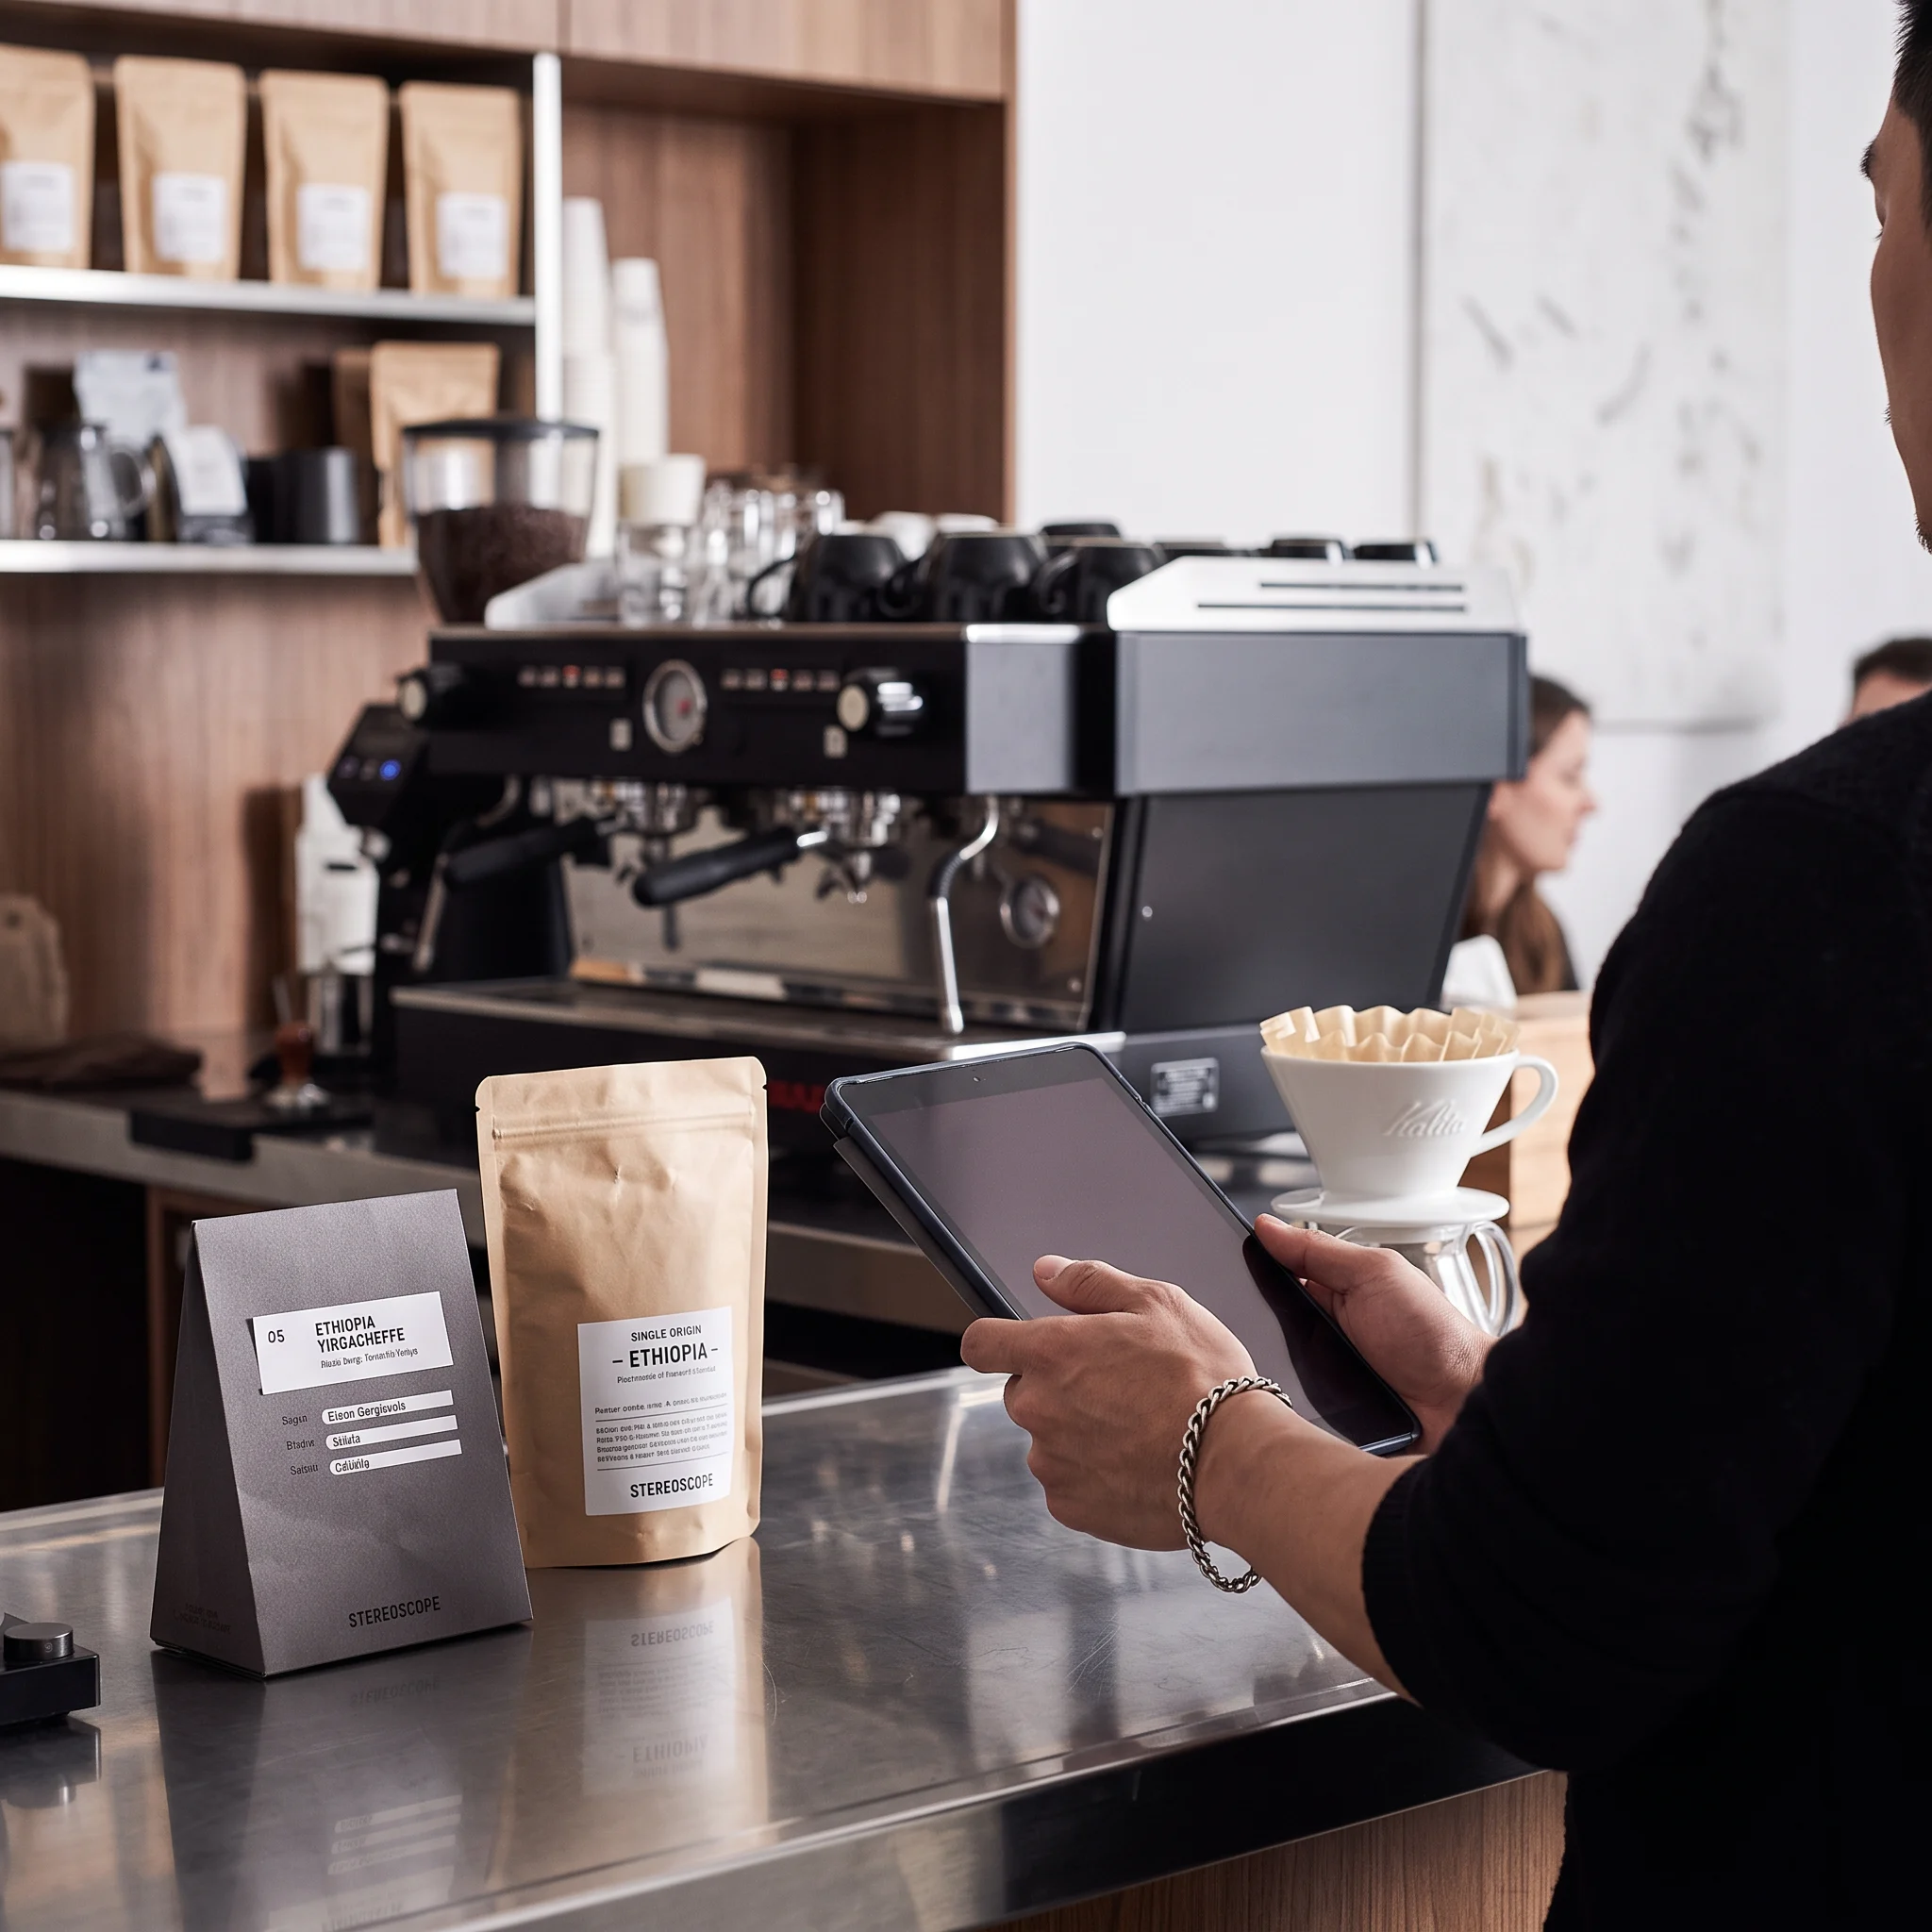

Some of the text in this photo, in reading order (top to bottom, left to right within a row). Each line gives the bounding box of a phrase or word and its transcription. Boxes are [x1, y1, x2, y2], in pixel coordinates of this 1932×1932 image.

[1382, 1099, 1467, 1138] Kalita
[268, 1329, 285, 1343] 05
[315, 1315, 375, 1336] ETHIOPIA
[631, 1324, 702, 1342] SINGLE ORIGIN
[317, 1327, 406, 1354] YIRGACHEFFE
[629, 1342, 708, 1368] ETHIOPIA
[630, 1474, 713, 1498] STEREOSCOPE
[348, 1596, 441, 1628] STEREOSCOPE
